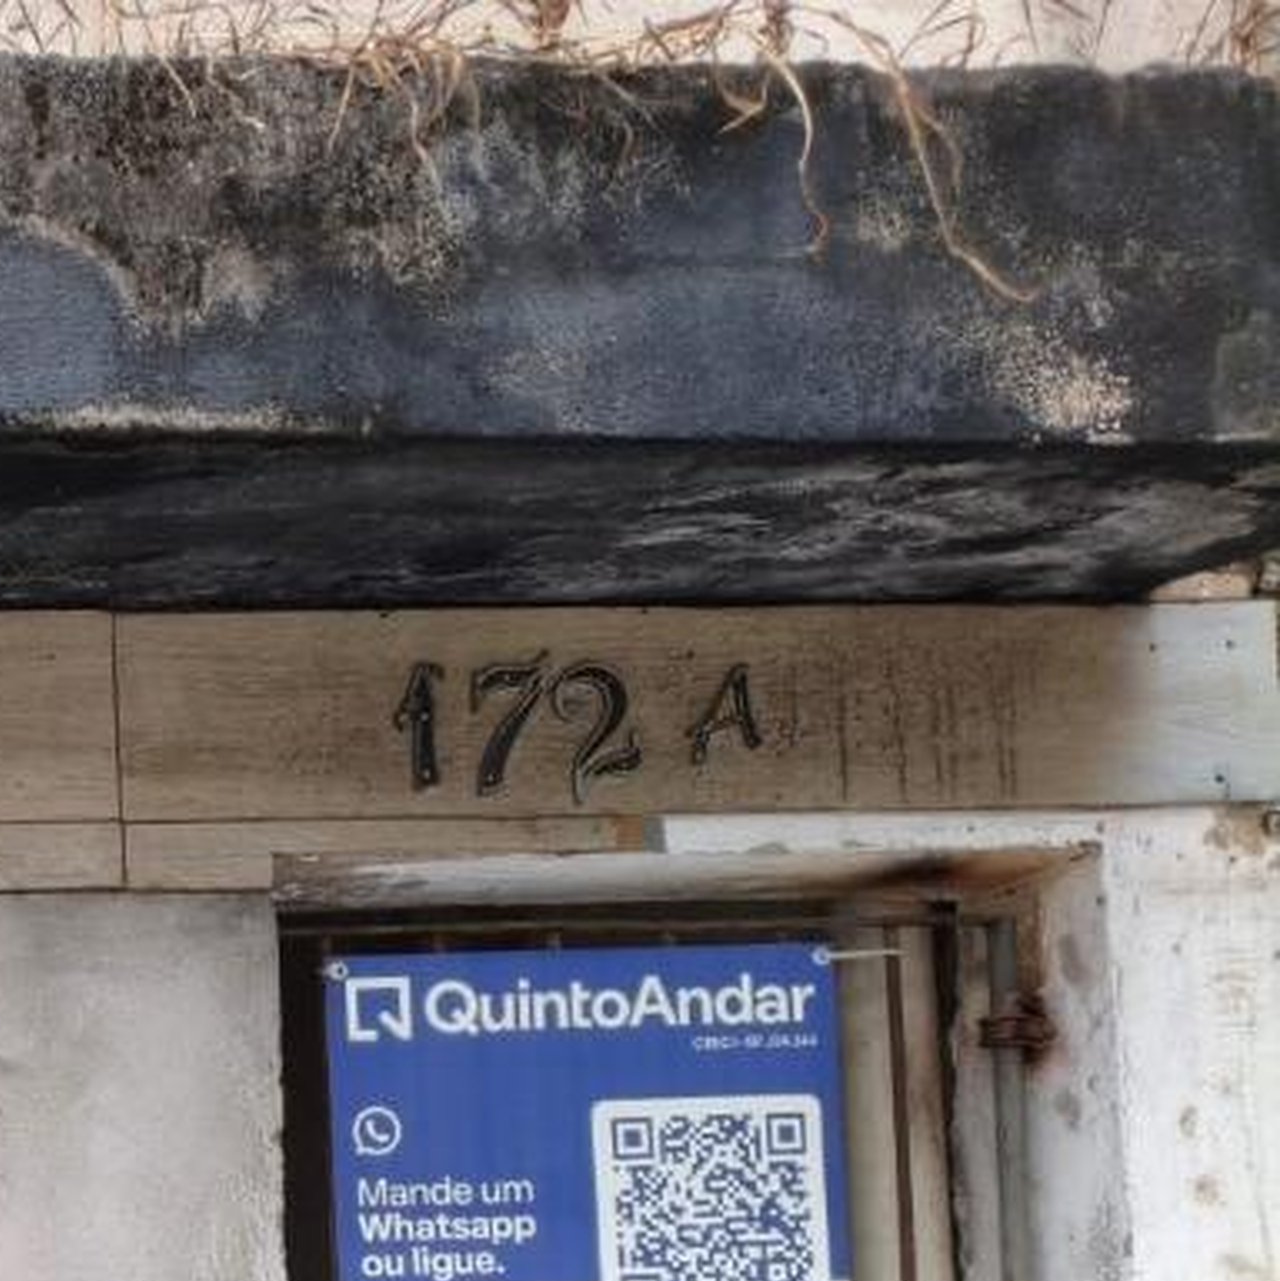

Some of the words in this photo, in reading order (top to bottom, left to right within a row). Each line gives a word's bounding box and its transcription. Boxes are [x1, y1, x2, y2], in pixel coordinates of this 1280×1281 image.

[392, 650, 641, 806] 172
[686, 662, 763, 766] A
[424, 973, 814, 1036] QuintoAndar
[357, 1176, 473, 1208] Mande
[482, 1181, 536, 1204] um
[358, 1213, 537, 1246] Whatsapp
[362, 1252, 406, 1277] ou
[413, 1245, 506, 1281] ligue.
